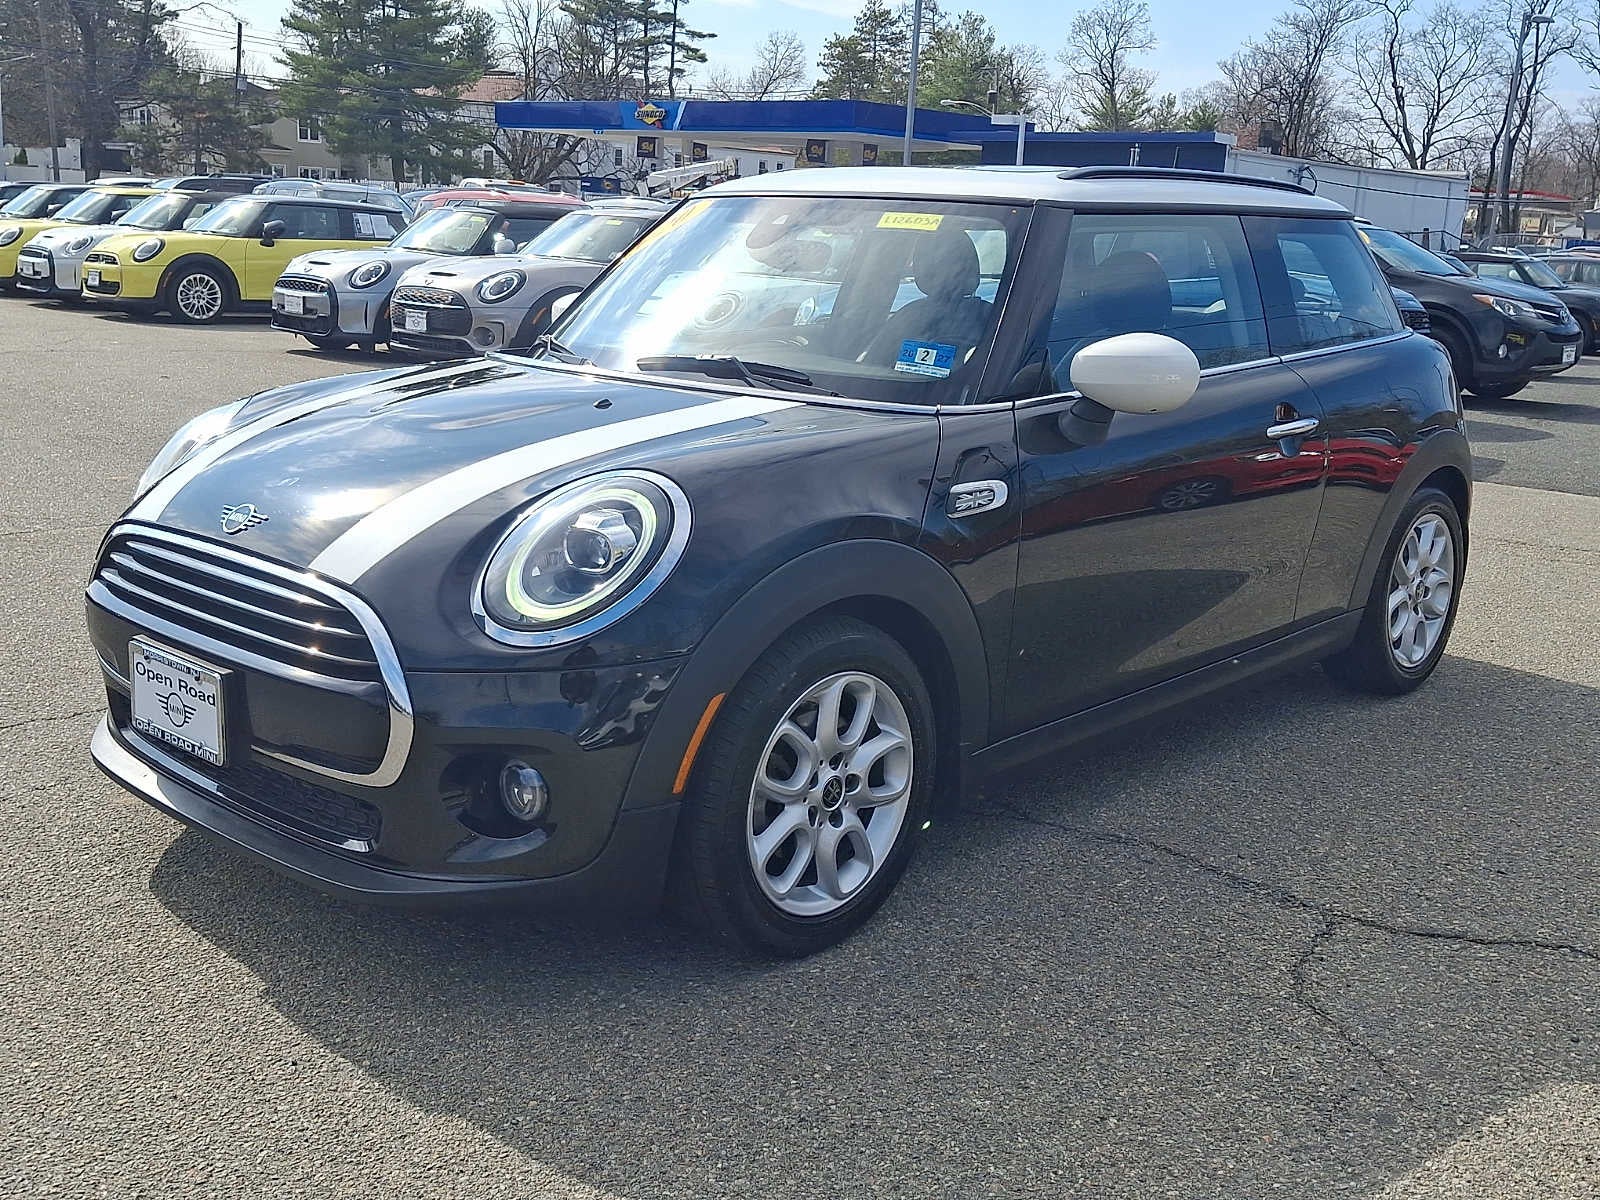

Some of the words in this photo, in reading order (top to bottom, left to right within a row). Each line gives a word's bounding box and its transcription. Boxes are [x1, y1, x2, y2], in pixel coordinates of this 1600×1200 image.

[636, 110, 664, 119] SUNOCO
[920, 350, 930, 362] 2
[135, 661, 173, 688] Open
[178, 678, 216, 707] Road
[169, 703, 184, 717] MINI
[136, 720, 162, 738] OPEN
[164, 732, 193, 751] ROAD
[194, 746, 218, 764] MINI
